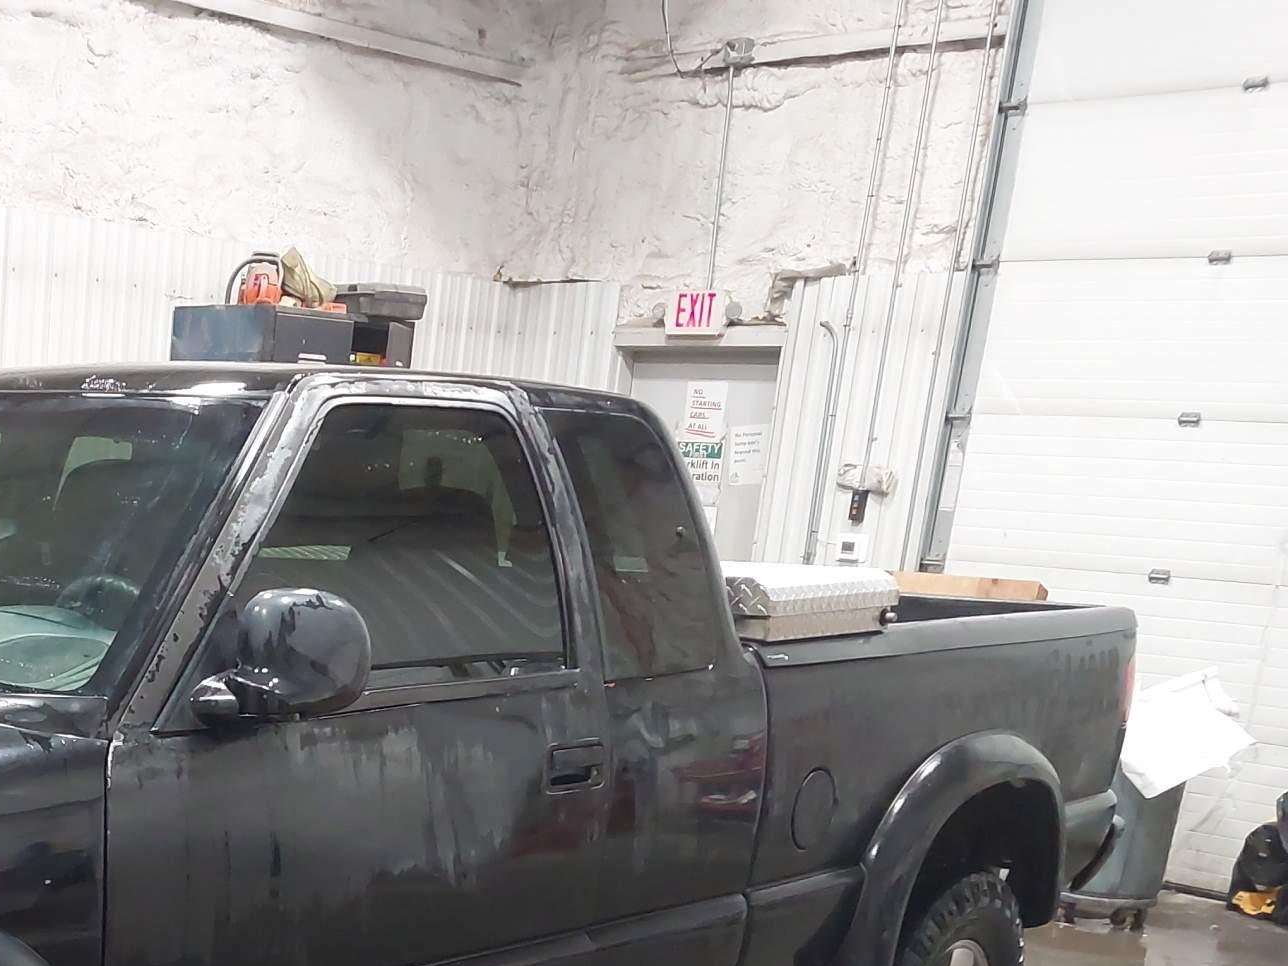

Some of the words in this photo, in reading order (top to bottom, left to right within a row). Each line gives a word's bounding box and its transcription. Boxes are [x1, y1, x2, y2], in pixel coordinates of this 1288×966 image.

[675, 293, 716, 328] EXIT
[691, 400, 721, 408] STARTING
[679, 442, 721, 454] SAFETY
[686, 460, 708, 470] rklift
[692, 472, 719, 481] ration
